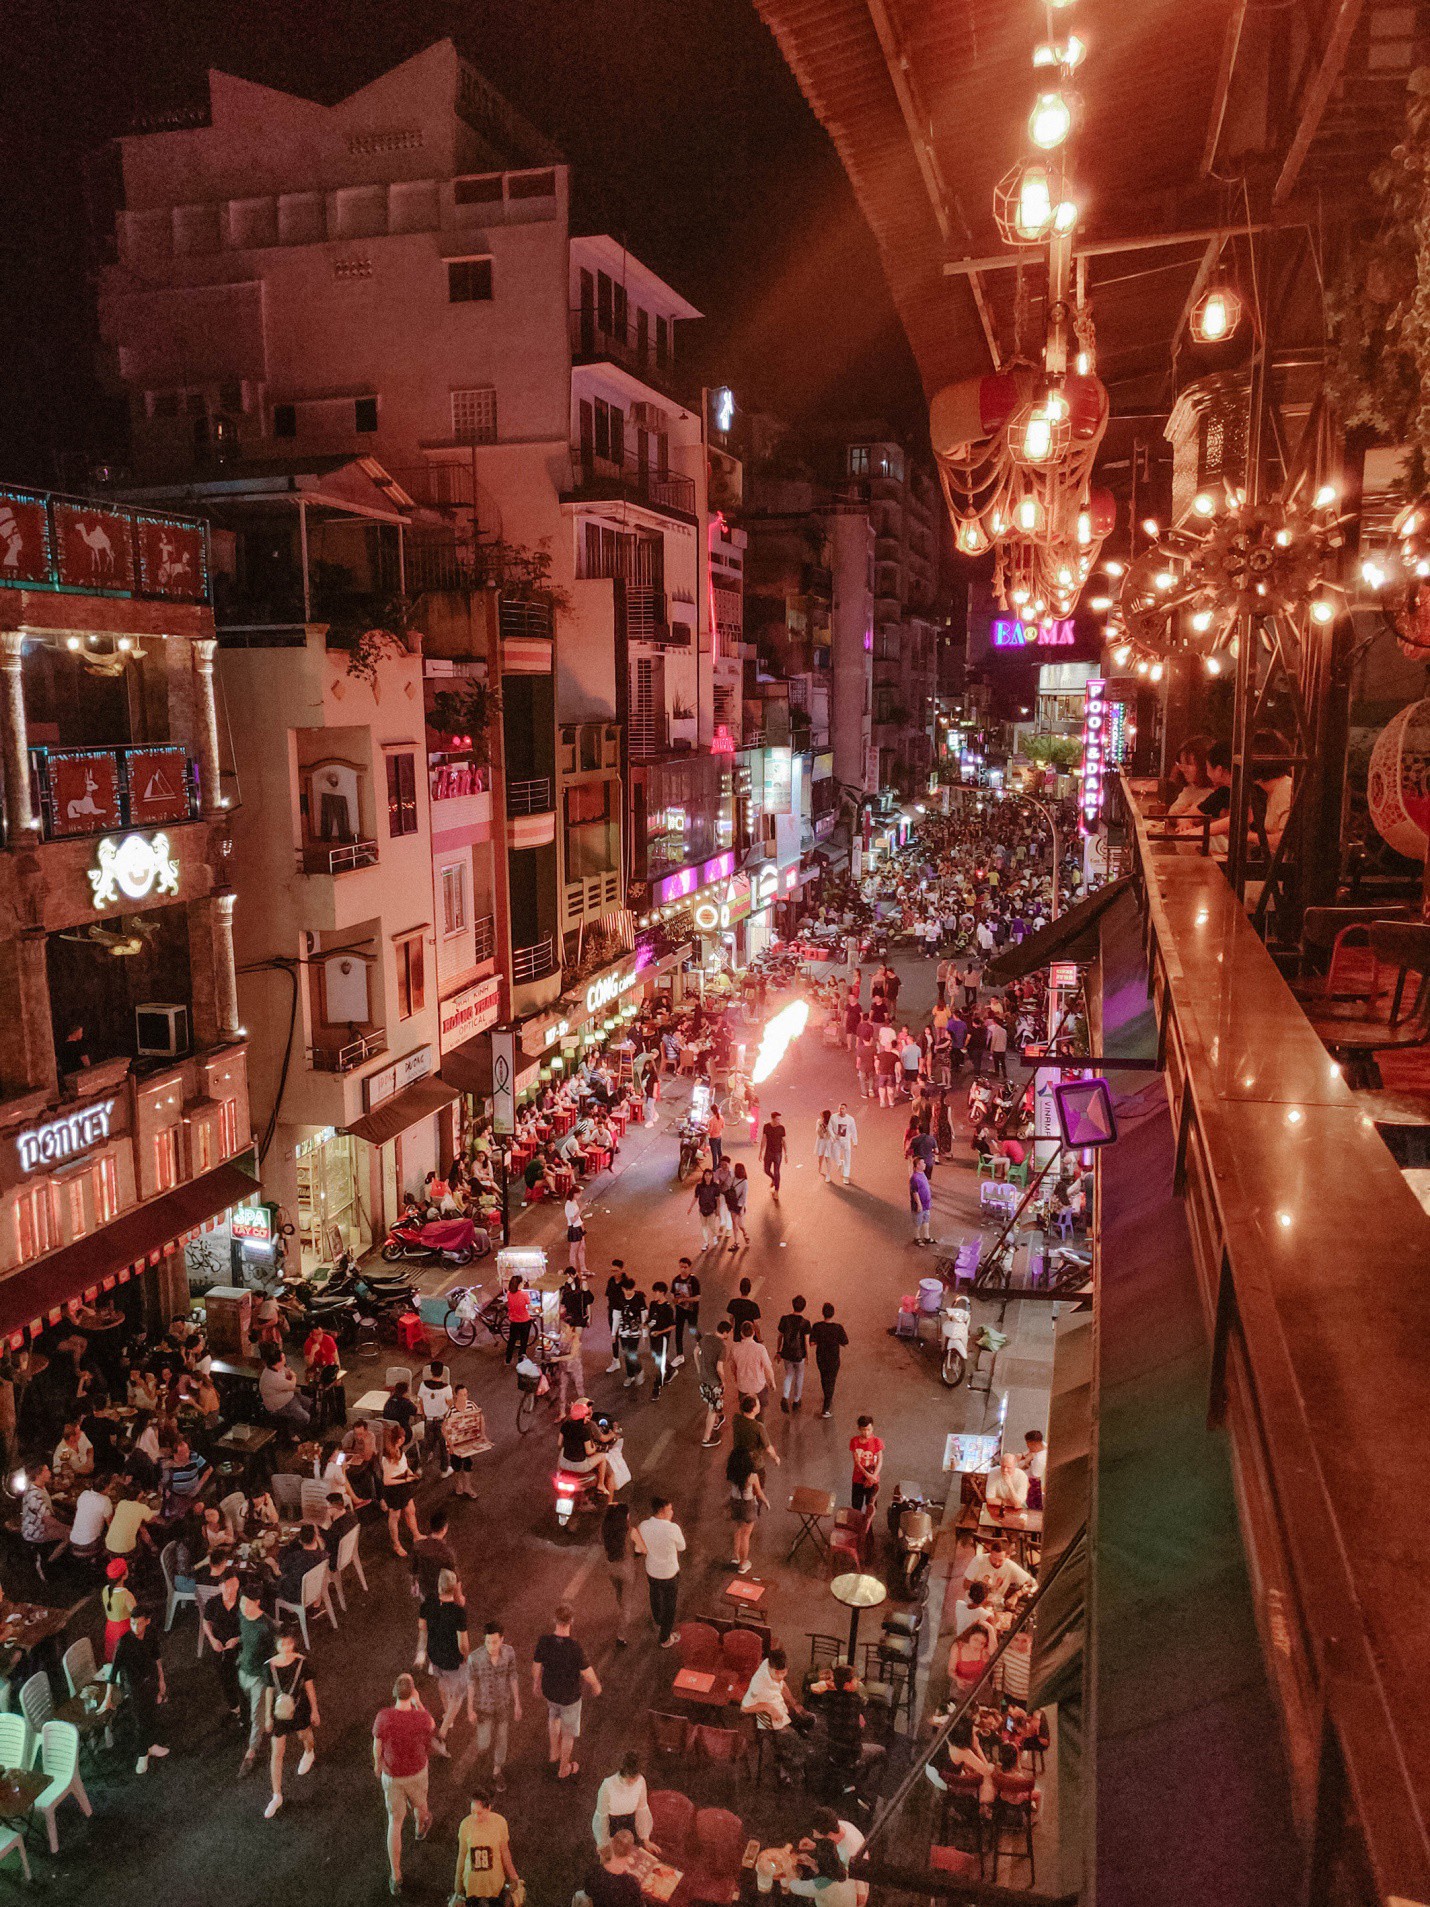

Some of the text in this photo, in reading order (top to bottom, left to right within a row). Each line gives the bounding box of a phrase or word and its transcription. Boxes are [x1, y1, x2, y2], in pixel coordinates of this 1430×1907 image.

[459, 1014, 487, 1035] OPTICAL
[17, 1098, 115, 1173] DONKEY
[233, 1208, 268, 1229] SPA
